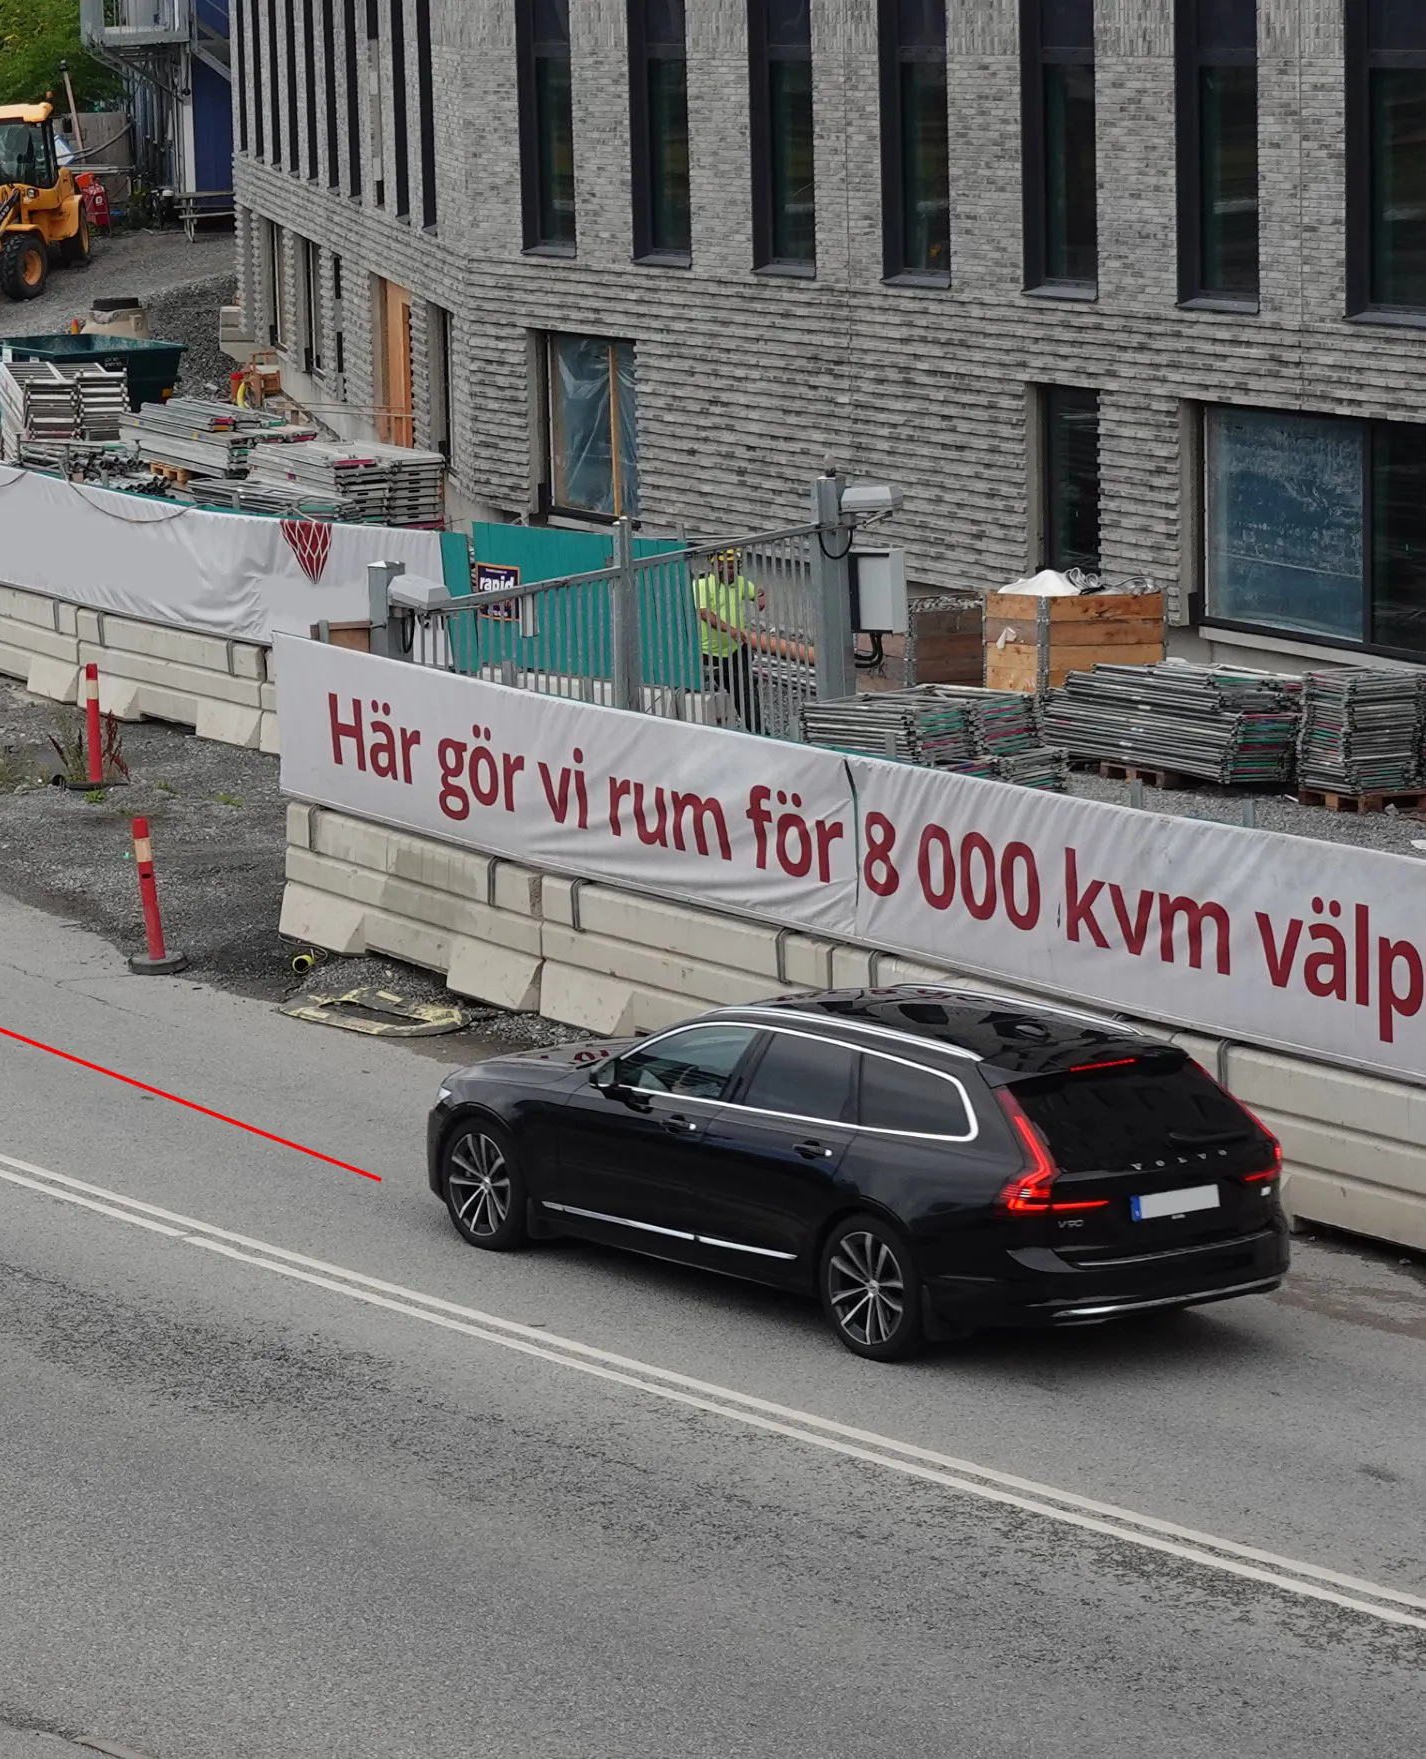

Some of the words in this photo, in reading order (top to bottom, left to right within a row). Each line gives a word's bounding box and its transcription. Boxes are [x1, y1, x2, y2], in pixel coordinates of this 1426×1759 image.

[328, 692, 422, 785] Här
[437, 723, 525, 821] gör
[538, 746, 588, 829] vi
[609, 777, 732, 861] rum
[745, 784, 844, 884] för
[864, 811, 900, 897] 8
[917, 823, 1042, 931] 000
[1065, 846, 1232, 975] kvm
[1255, 896, 1425, 1043] välp
[1130, 1149, 1228, 1171] VOLVO
[1057, 1219, 1083, 1229] V90
